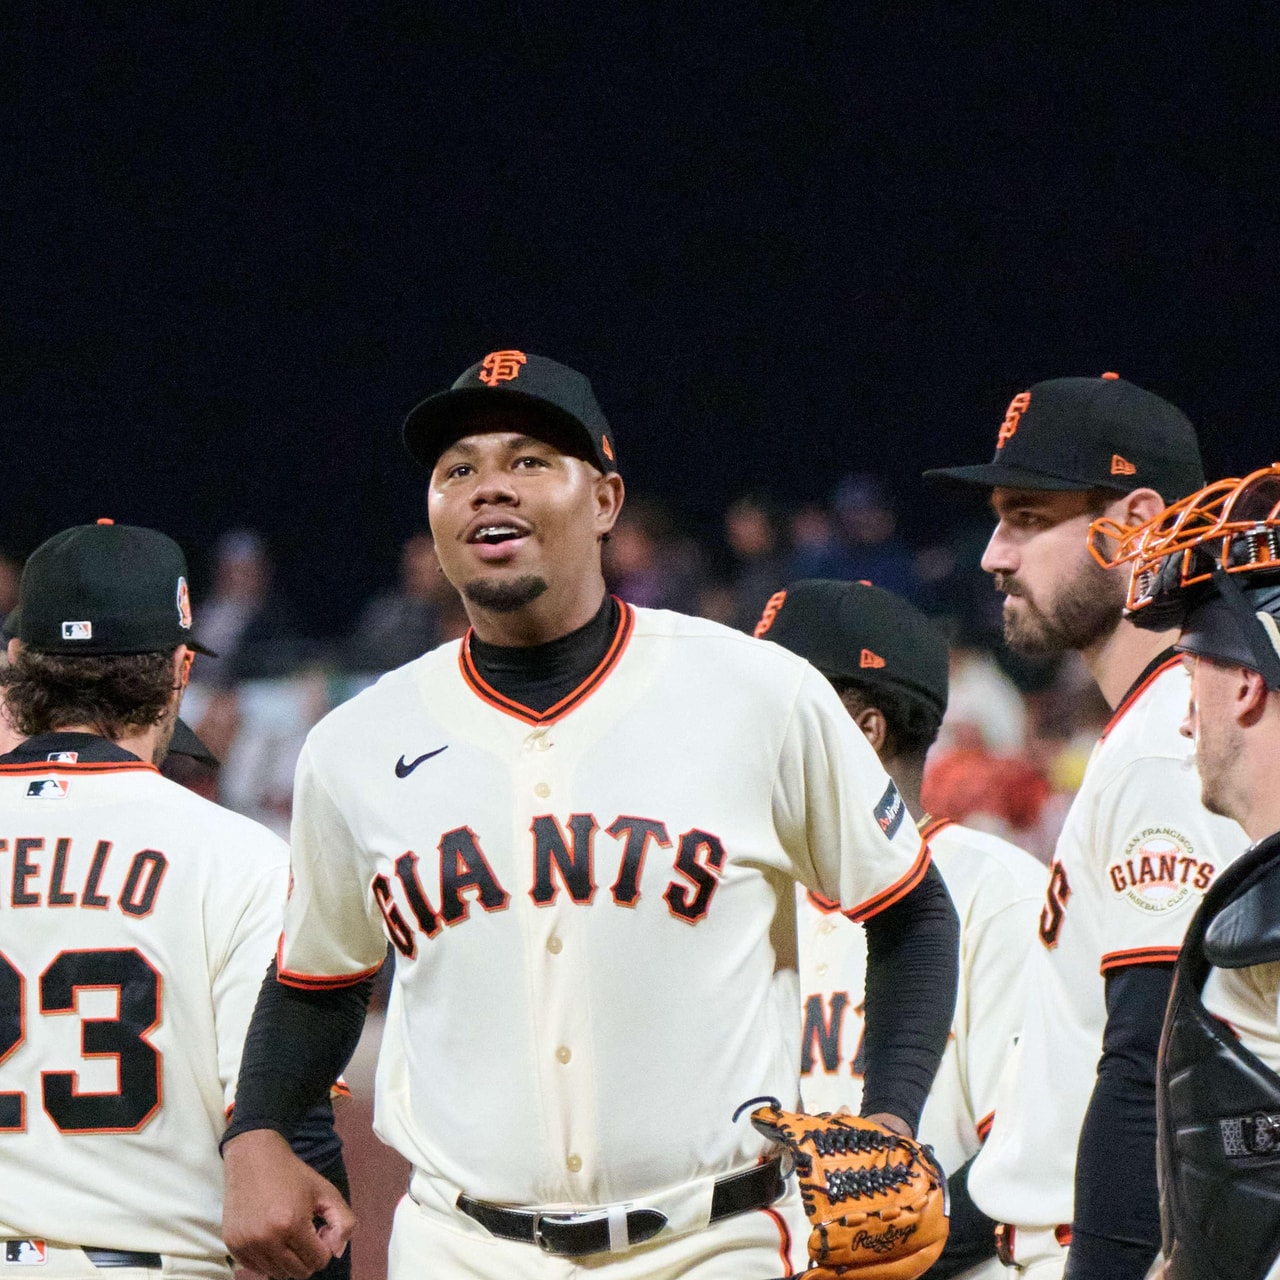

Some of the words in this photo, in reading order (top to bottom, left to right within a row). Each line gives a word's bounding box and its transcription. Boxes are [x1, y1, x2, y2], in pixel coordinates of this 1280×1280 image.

[1125, 835, 1141, 856] SAN
[1141, 827, 1195, 854] FRANCISCO
[371, 812, 728, 961] GIANTS
[1109, 855, 1216, 893] GIANTS
[852, 1223, 918, 1254] Rawlings
